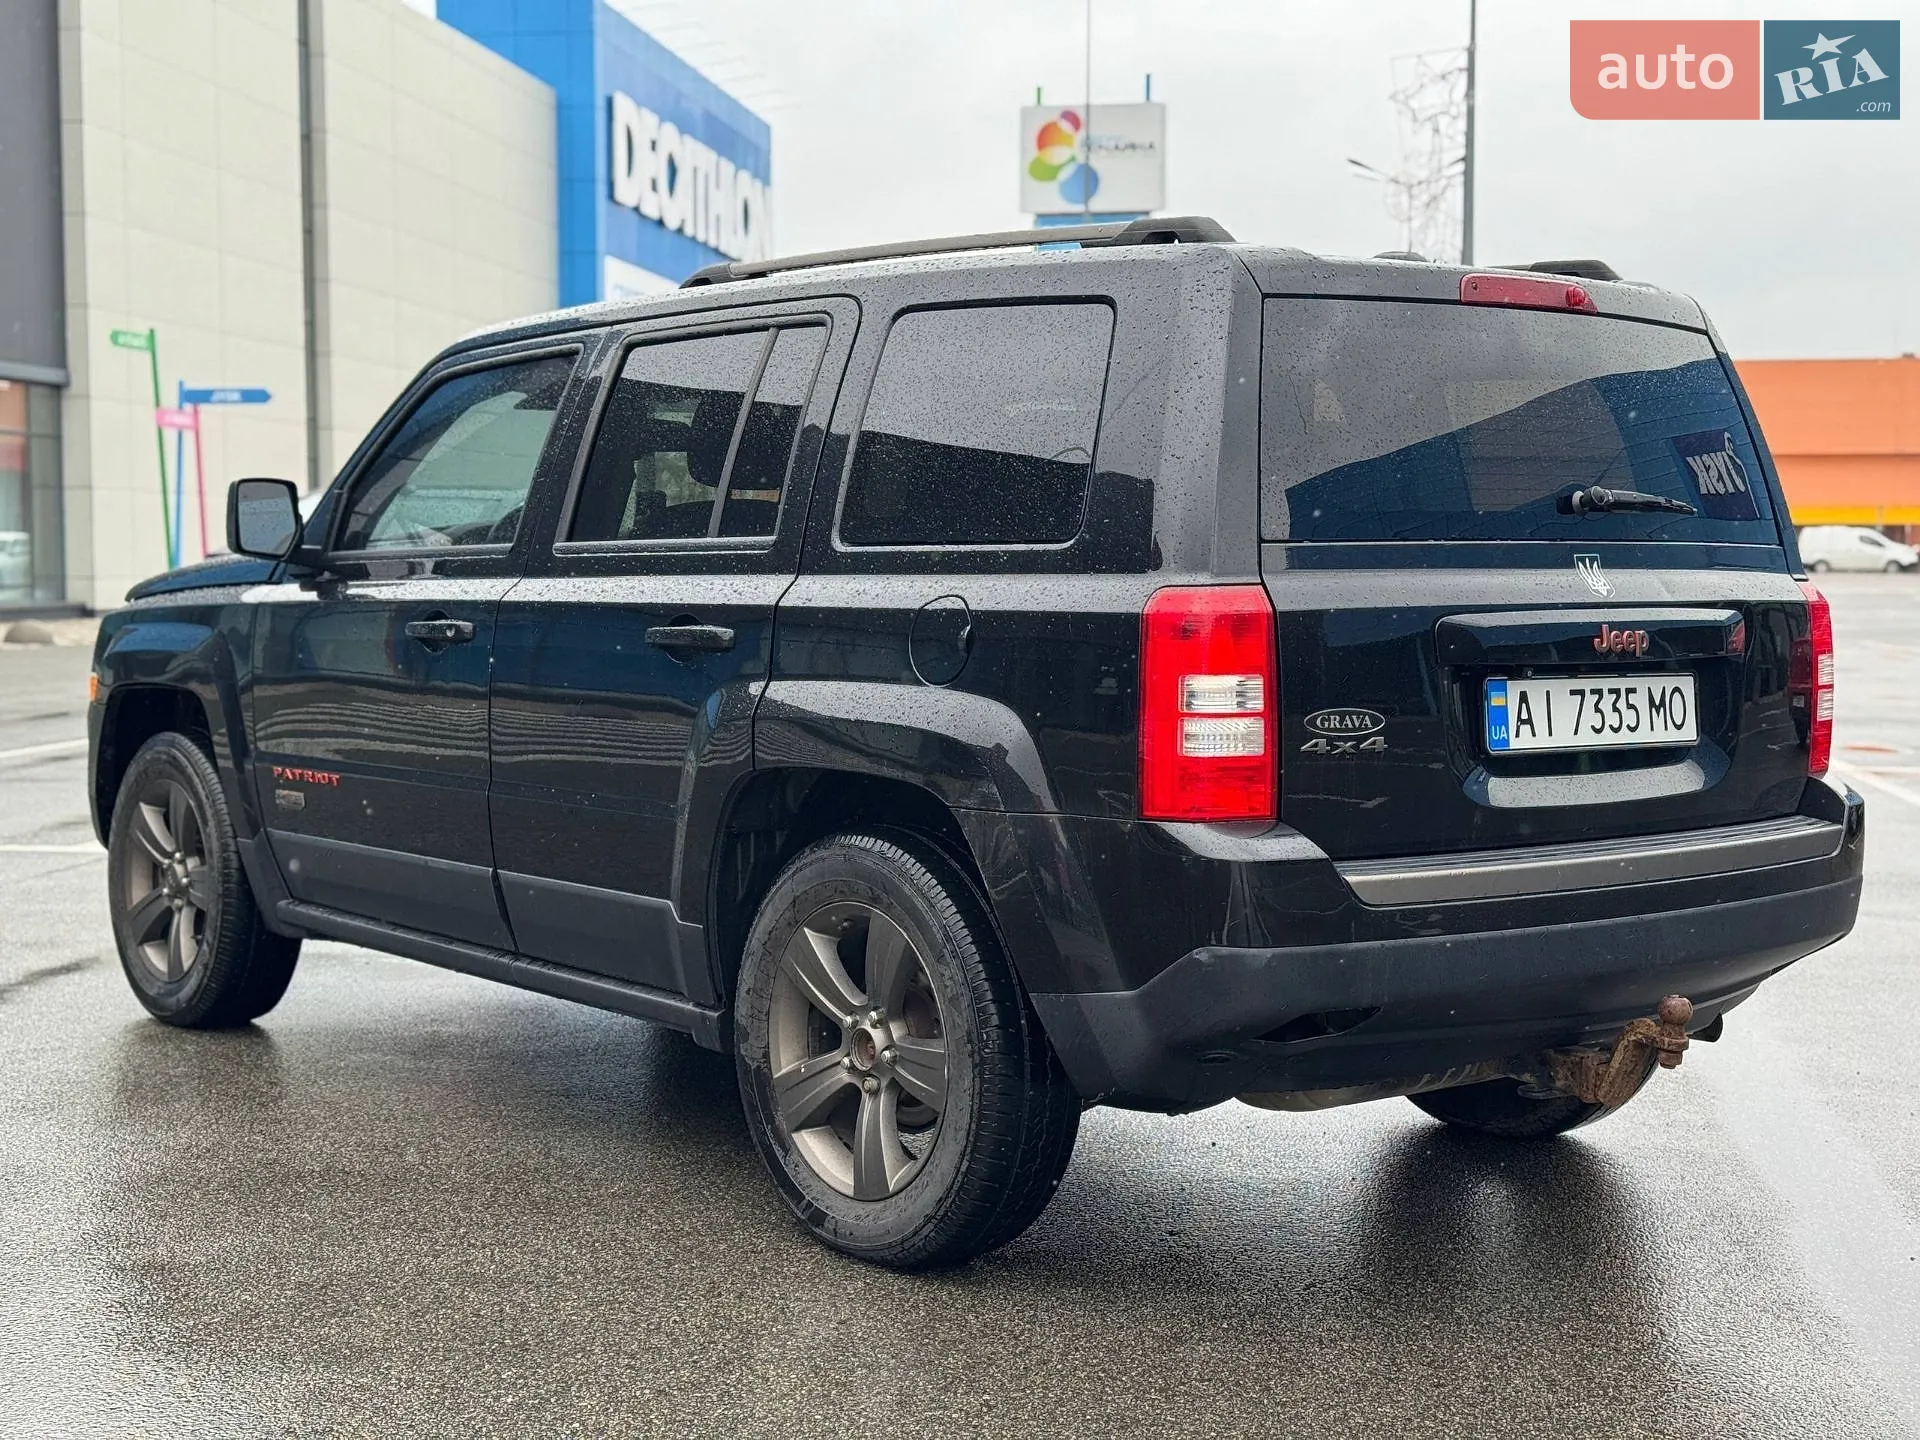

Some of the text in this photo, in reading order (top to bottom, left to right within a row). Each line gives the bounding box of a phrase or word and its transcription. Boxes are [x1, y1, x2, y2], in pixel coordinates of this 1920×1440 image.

[609, 90, 772, 262] DECATHLON
[1593, 624, 1650, 658] Jeep
[1316, 714, 1373, 729] GRAVA
[1515, 686, 1687, 739] AI 7335 MO
[1492, 725, 1508, 741] UA
[1300, 736, 1389, 755] 4x4
[272, 766, 341, 788] PATRIOT
